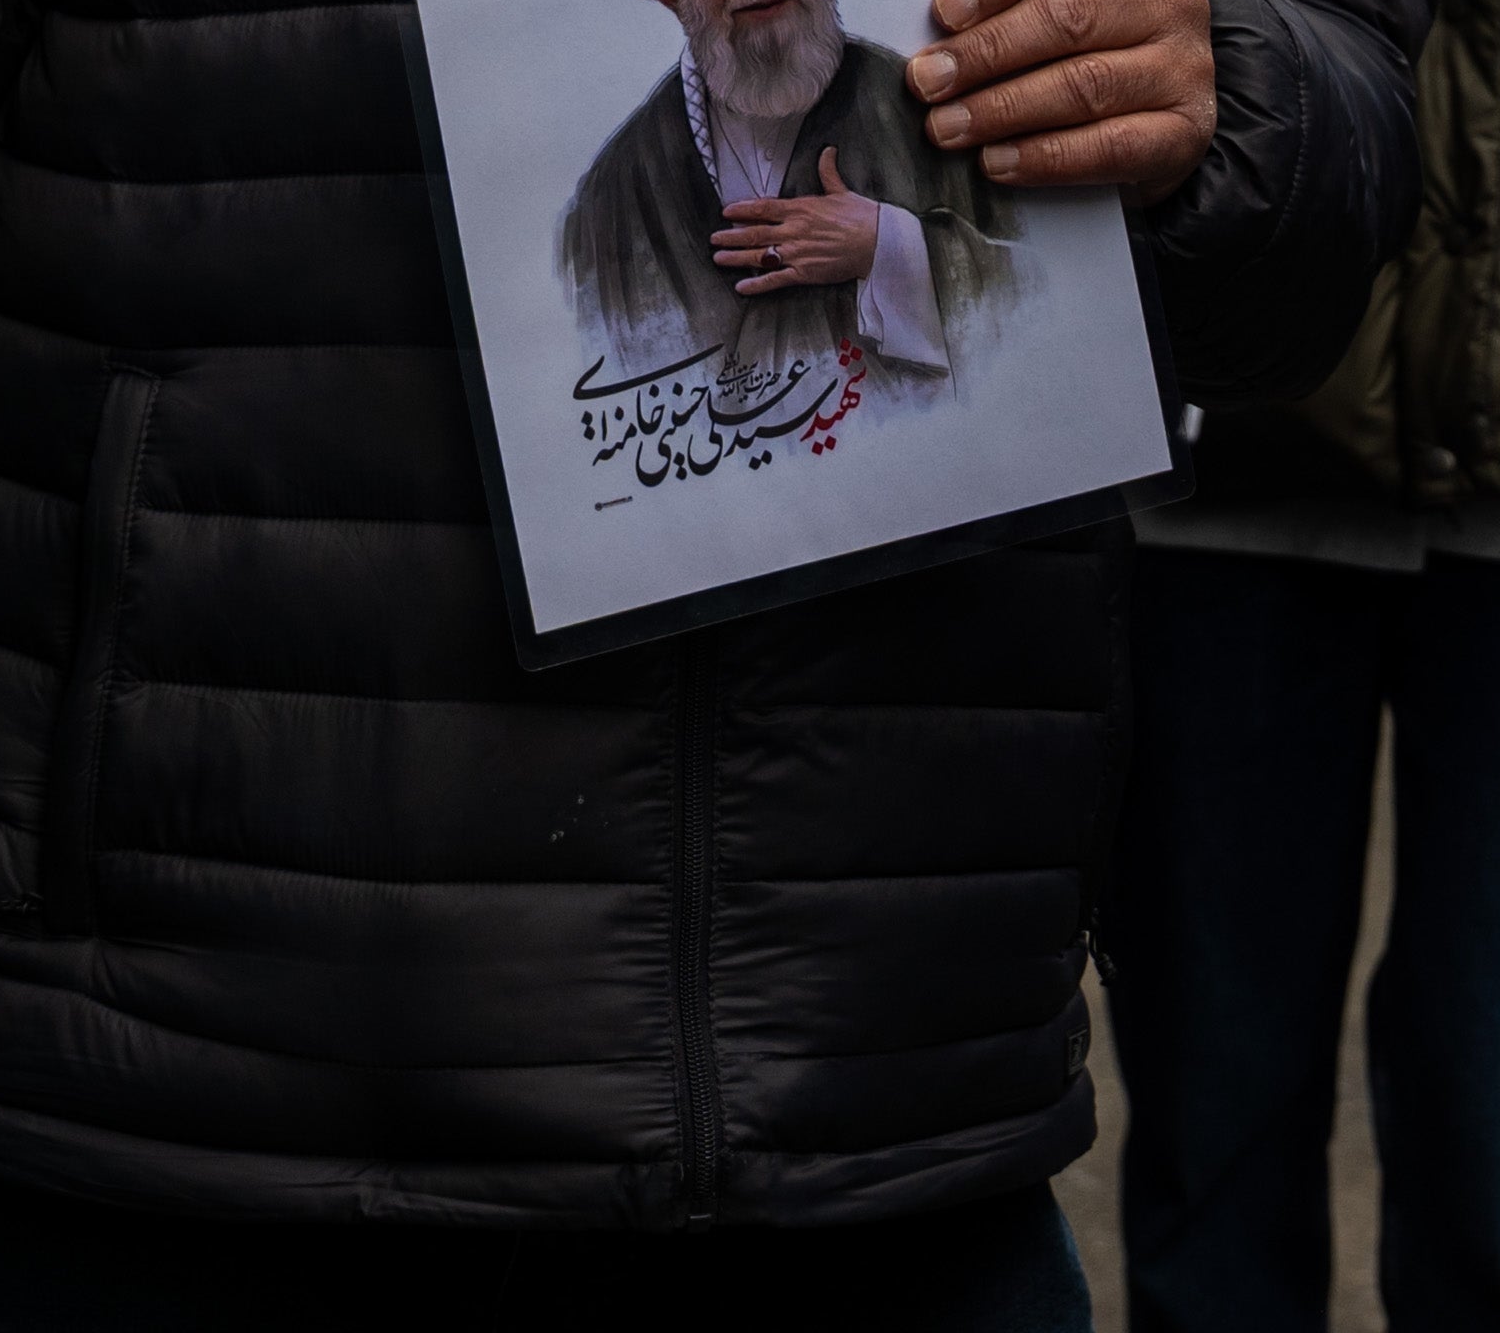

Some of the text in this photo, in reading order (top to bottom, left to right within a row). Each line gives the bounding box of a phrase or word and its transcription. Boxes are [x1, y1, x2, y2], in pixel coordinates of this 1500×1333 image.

[687, 358, 812, 477] علی
[723, 377, 840, 471] سید
[800, 337, 867, 456] شهید
